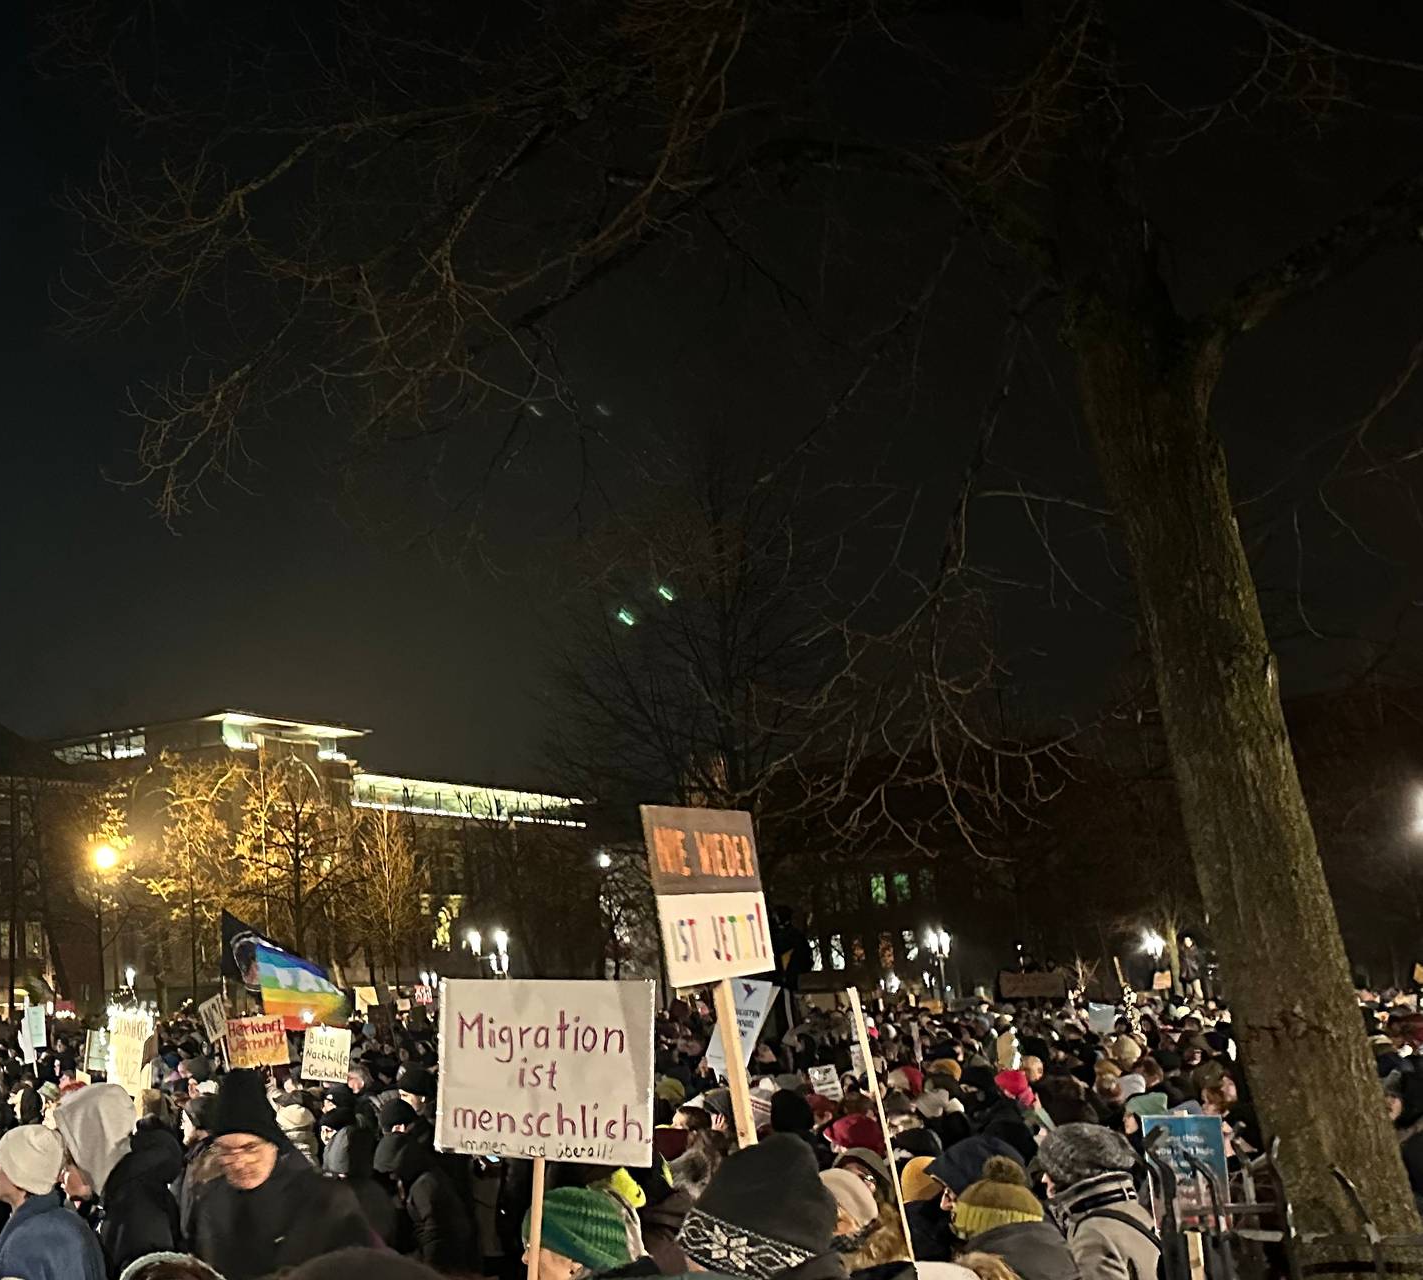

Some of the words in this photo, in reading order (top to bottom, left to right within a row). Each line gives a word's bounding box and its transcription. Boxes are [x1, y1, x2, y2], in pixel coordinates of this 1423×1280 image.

[653, 826, 691, 877] NIE
[694, 831, 755, 877] WIEDER
[670, 918, 701, 963] IST
[227, 1018, 282, 1038] Herkunft
[308, 1032, 335, 1048] Biete
[457, 1009, 625, 1063] Migration
[305, 1047, 349, 1066] Nachhilfe
[308, 1063, 347, 1080] Geschichte
[518, 1057, 557, 1091] ist
[453, 1101, 652, 1144] menschlich.
[520, 1143, 547, 1157] und
[557, 1141, 616, 1161] überall!
